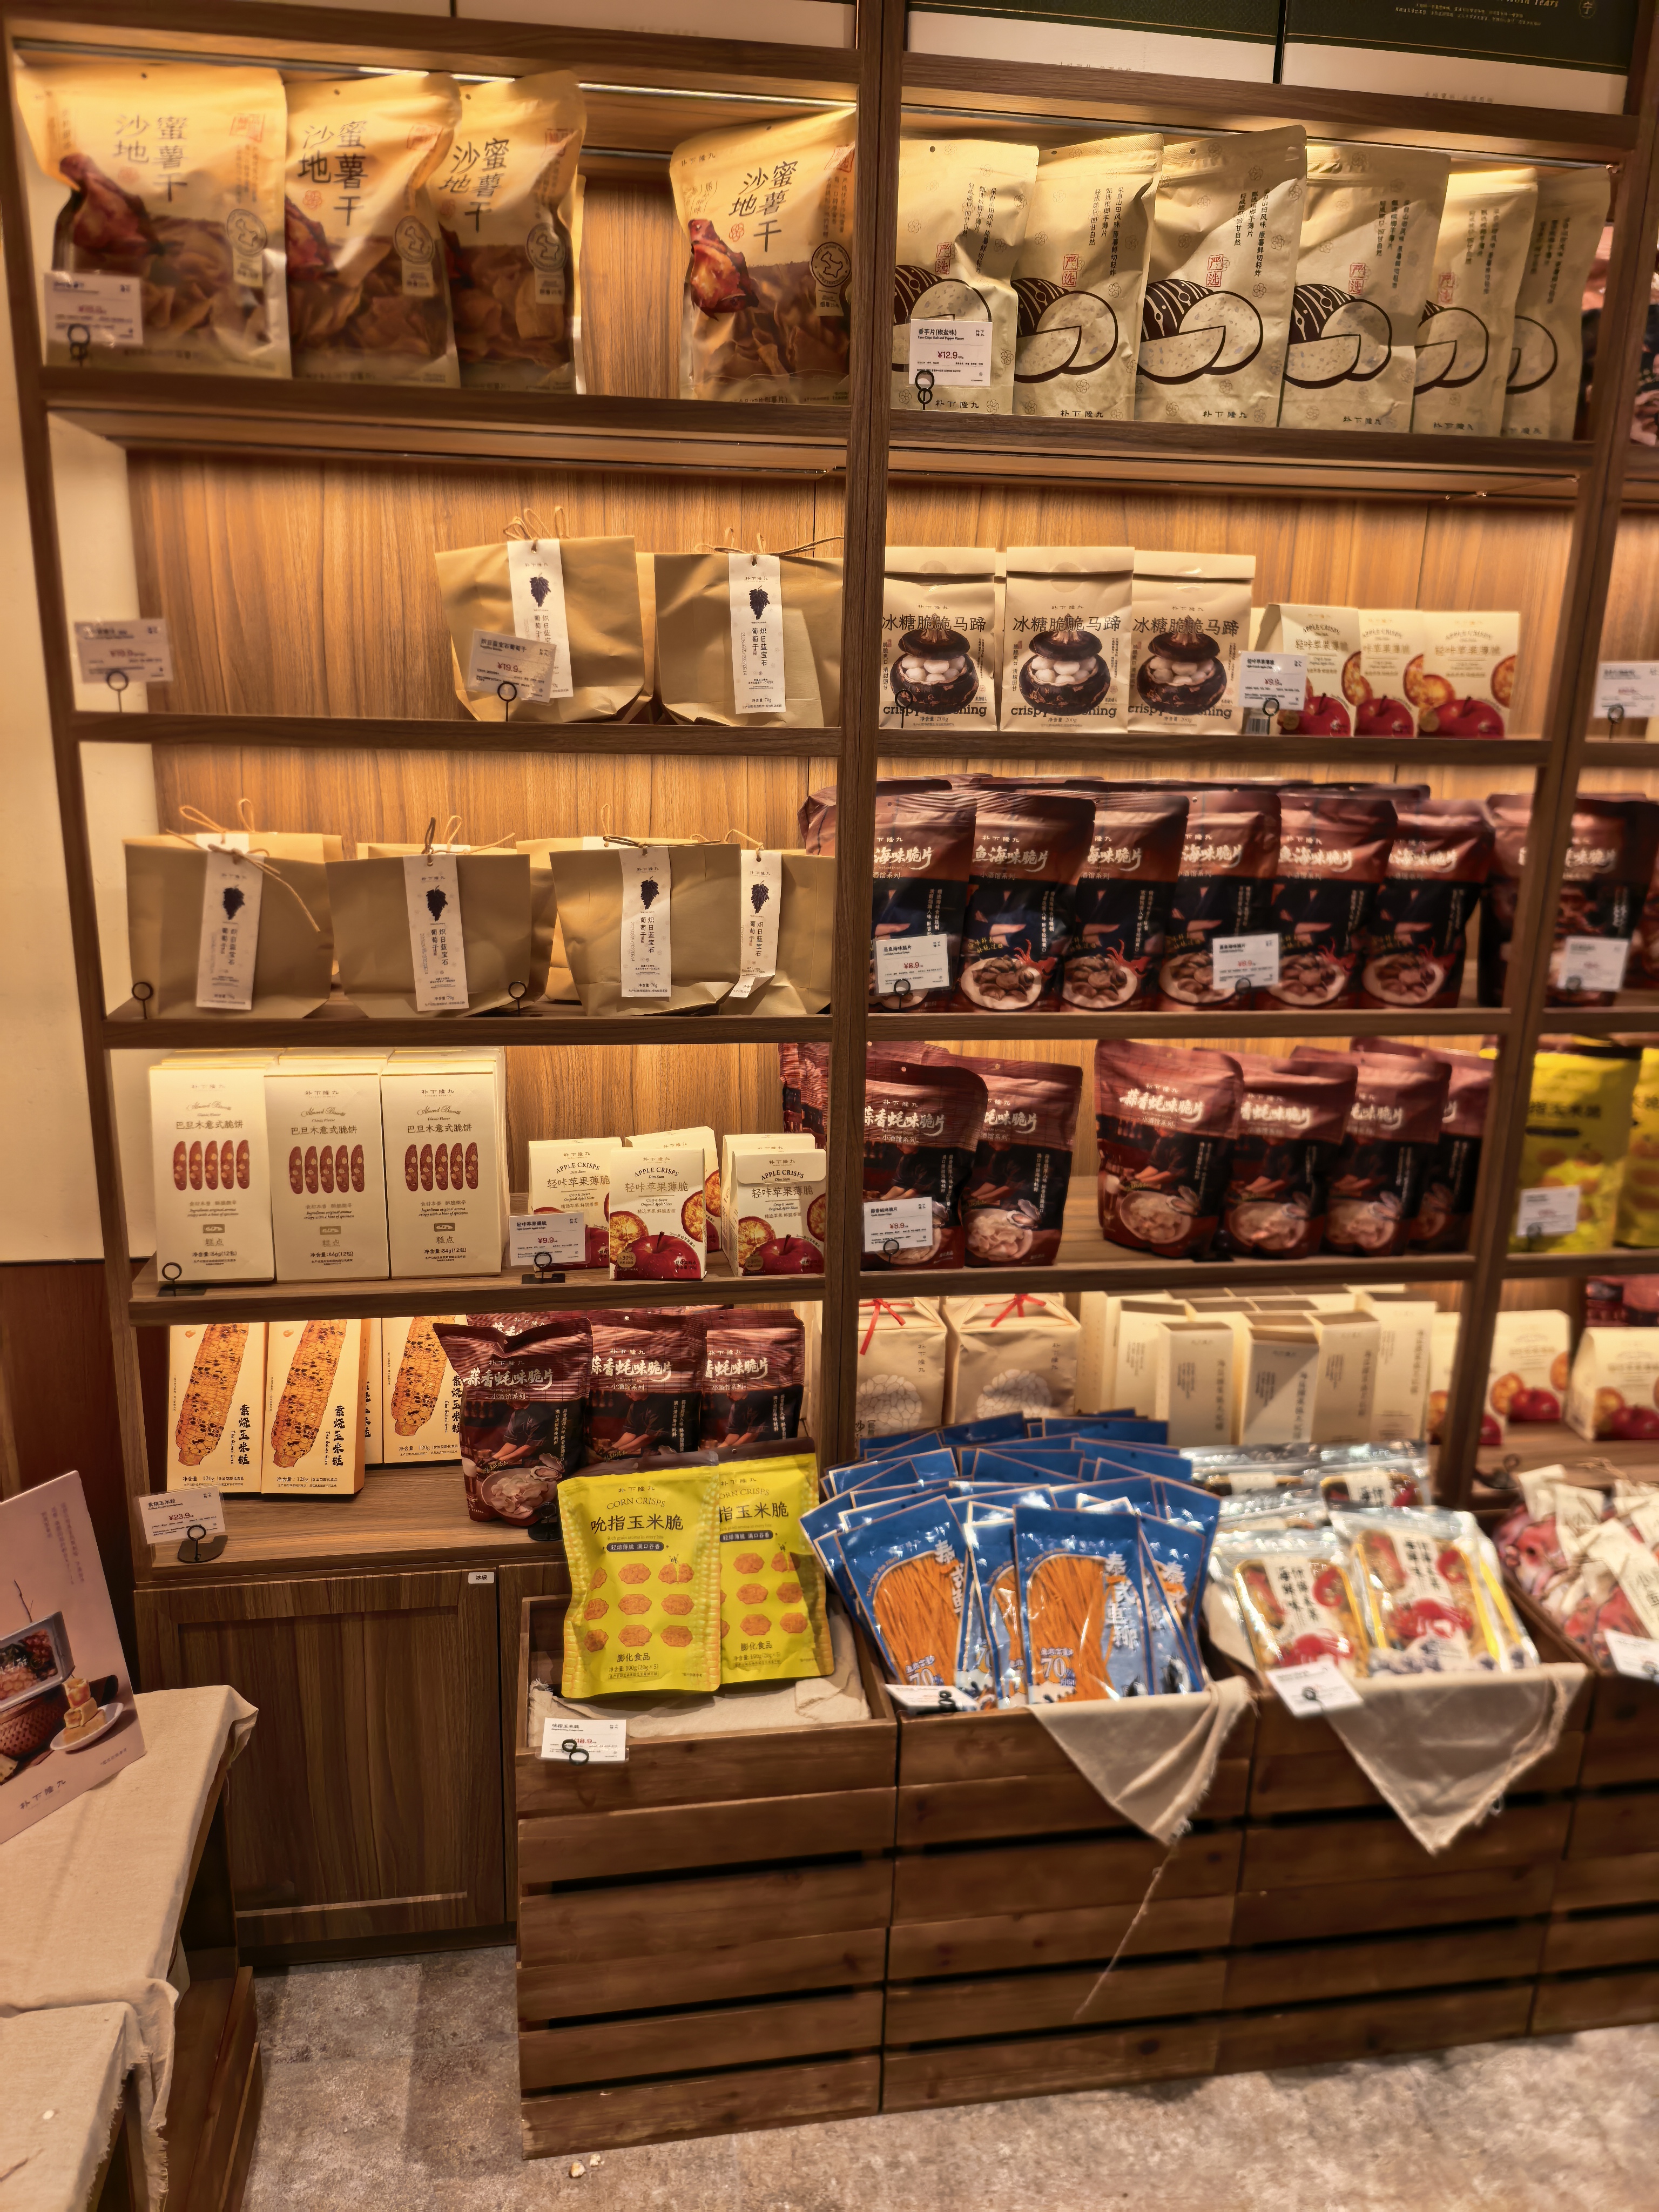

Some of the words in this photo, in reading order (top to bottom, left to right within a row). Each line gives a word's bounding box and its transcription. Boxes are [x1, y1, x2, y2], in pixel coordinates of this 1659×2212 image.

[112, 114, 150, 163] 沙地
[153, 116, 188, 203] 蜜薯干
[298, 125, 335, 184] 沙地
[333, 120, 368, 226] 蜜薯干
[439, 141, 480, 193] 沙地
[465, 138, 509, 233] 蜜薯干
[729, 167, 768, 217] 沙地
[753, 161, 798, 252] 蜜薯干
[937, 243, 952, 274] 严选
[1063, 255, 1079, 286] 严选
[1207, 255, 1223, 287] 严选
[938, 351, 958, 359] ¥12.9
[935, 400, 979, 409] 朴下隆九
[1061, 409, 1104, 419] 朴下隆九
[1203, 409, 1248, 419] 朴下隆九
[882, 614, 986, 632] 冰糖脆脆马蹄
[1013, 616, 1121, 632] 冰糖脆脆马蹄
[1132, 617, 1239, 636] 冰糖脆脆马蹄
[497, 662, 518, 672] ¥19.9
[874, 845, 934, 870] 海味脆片
[973, 845, 1049, 872] 鱼海味脆片
[1120, 1089, 1204, 1123] 蒜香蚝味脆片
[176, 1120, 244, 1129] 巴旦木意式脆饼
[291, 1125, 358, 1135] 巴旦木意式脆饼
[407, 1124, 472, 1134] 巴旦木意式脆饼
[865, 1106, 945, 1136] 蒜香蚝味脆片
[556, 1163, 576, 1174] APPLE
[578, 1162, 600, 1171] CRISPS
[635, 1168, 654, 1177] APPLE
[656, 1167, 679, 1176] CRISPS
[761, 1170, 780, 1181] APPLE
[782, 1170, 804, 1178] CRISPS
[547, 1175, 610, 1189] 轻咔苹果薄脆
[625, 1182, 689, 1192] 轻咔苹果薄脆
[752, 1186, 813, 1198] 轻咔苹果薄脆
[436, 1236, 454, 1244] 糕点
[918, 1343, 926, 1372] 朴下隆九
[591, 1355, 672, 1382] 蒜香蚝味脆片
[463, 1367, 553, 1391] 蒜香蚝味脆片
[451, 1375, 462, 1433] 素烧玉米粒
[238, 1404, 251, 1465] 素烧玉米粒
[332, 1405, 345, 1466] 素烧玉米粒
[740, 1488, 769, 1497] CRISPS
[607, 1498, 633, 1510] CORN
[636, 1497, 665, 1508] CRISPS
[719, 1501, 788, 1522] 指玉米脆
[168, 1513, 190, 1521] ¥23.9
[591, 1514, 683, 1534] 吮指玉米脆
[740, 1641, 772, 1651] 膨化食品
[617, 1653, 650, 1662] 膨化食品
[1041, 1657, 1065, 1676] 70
